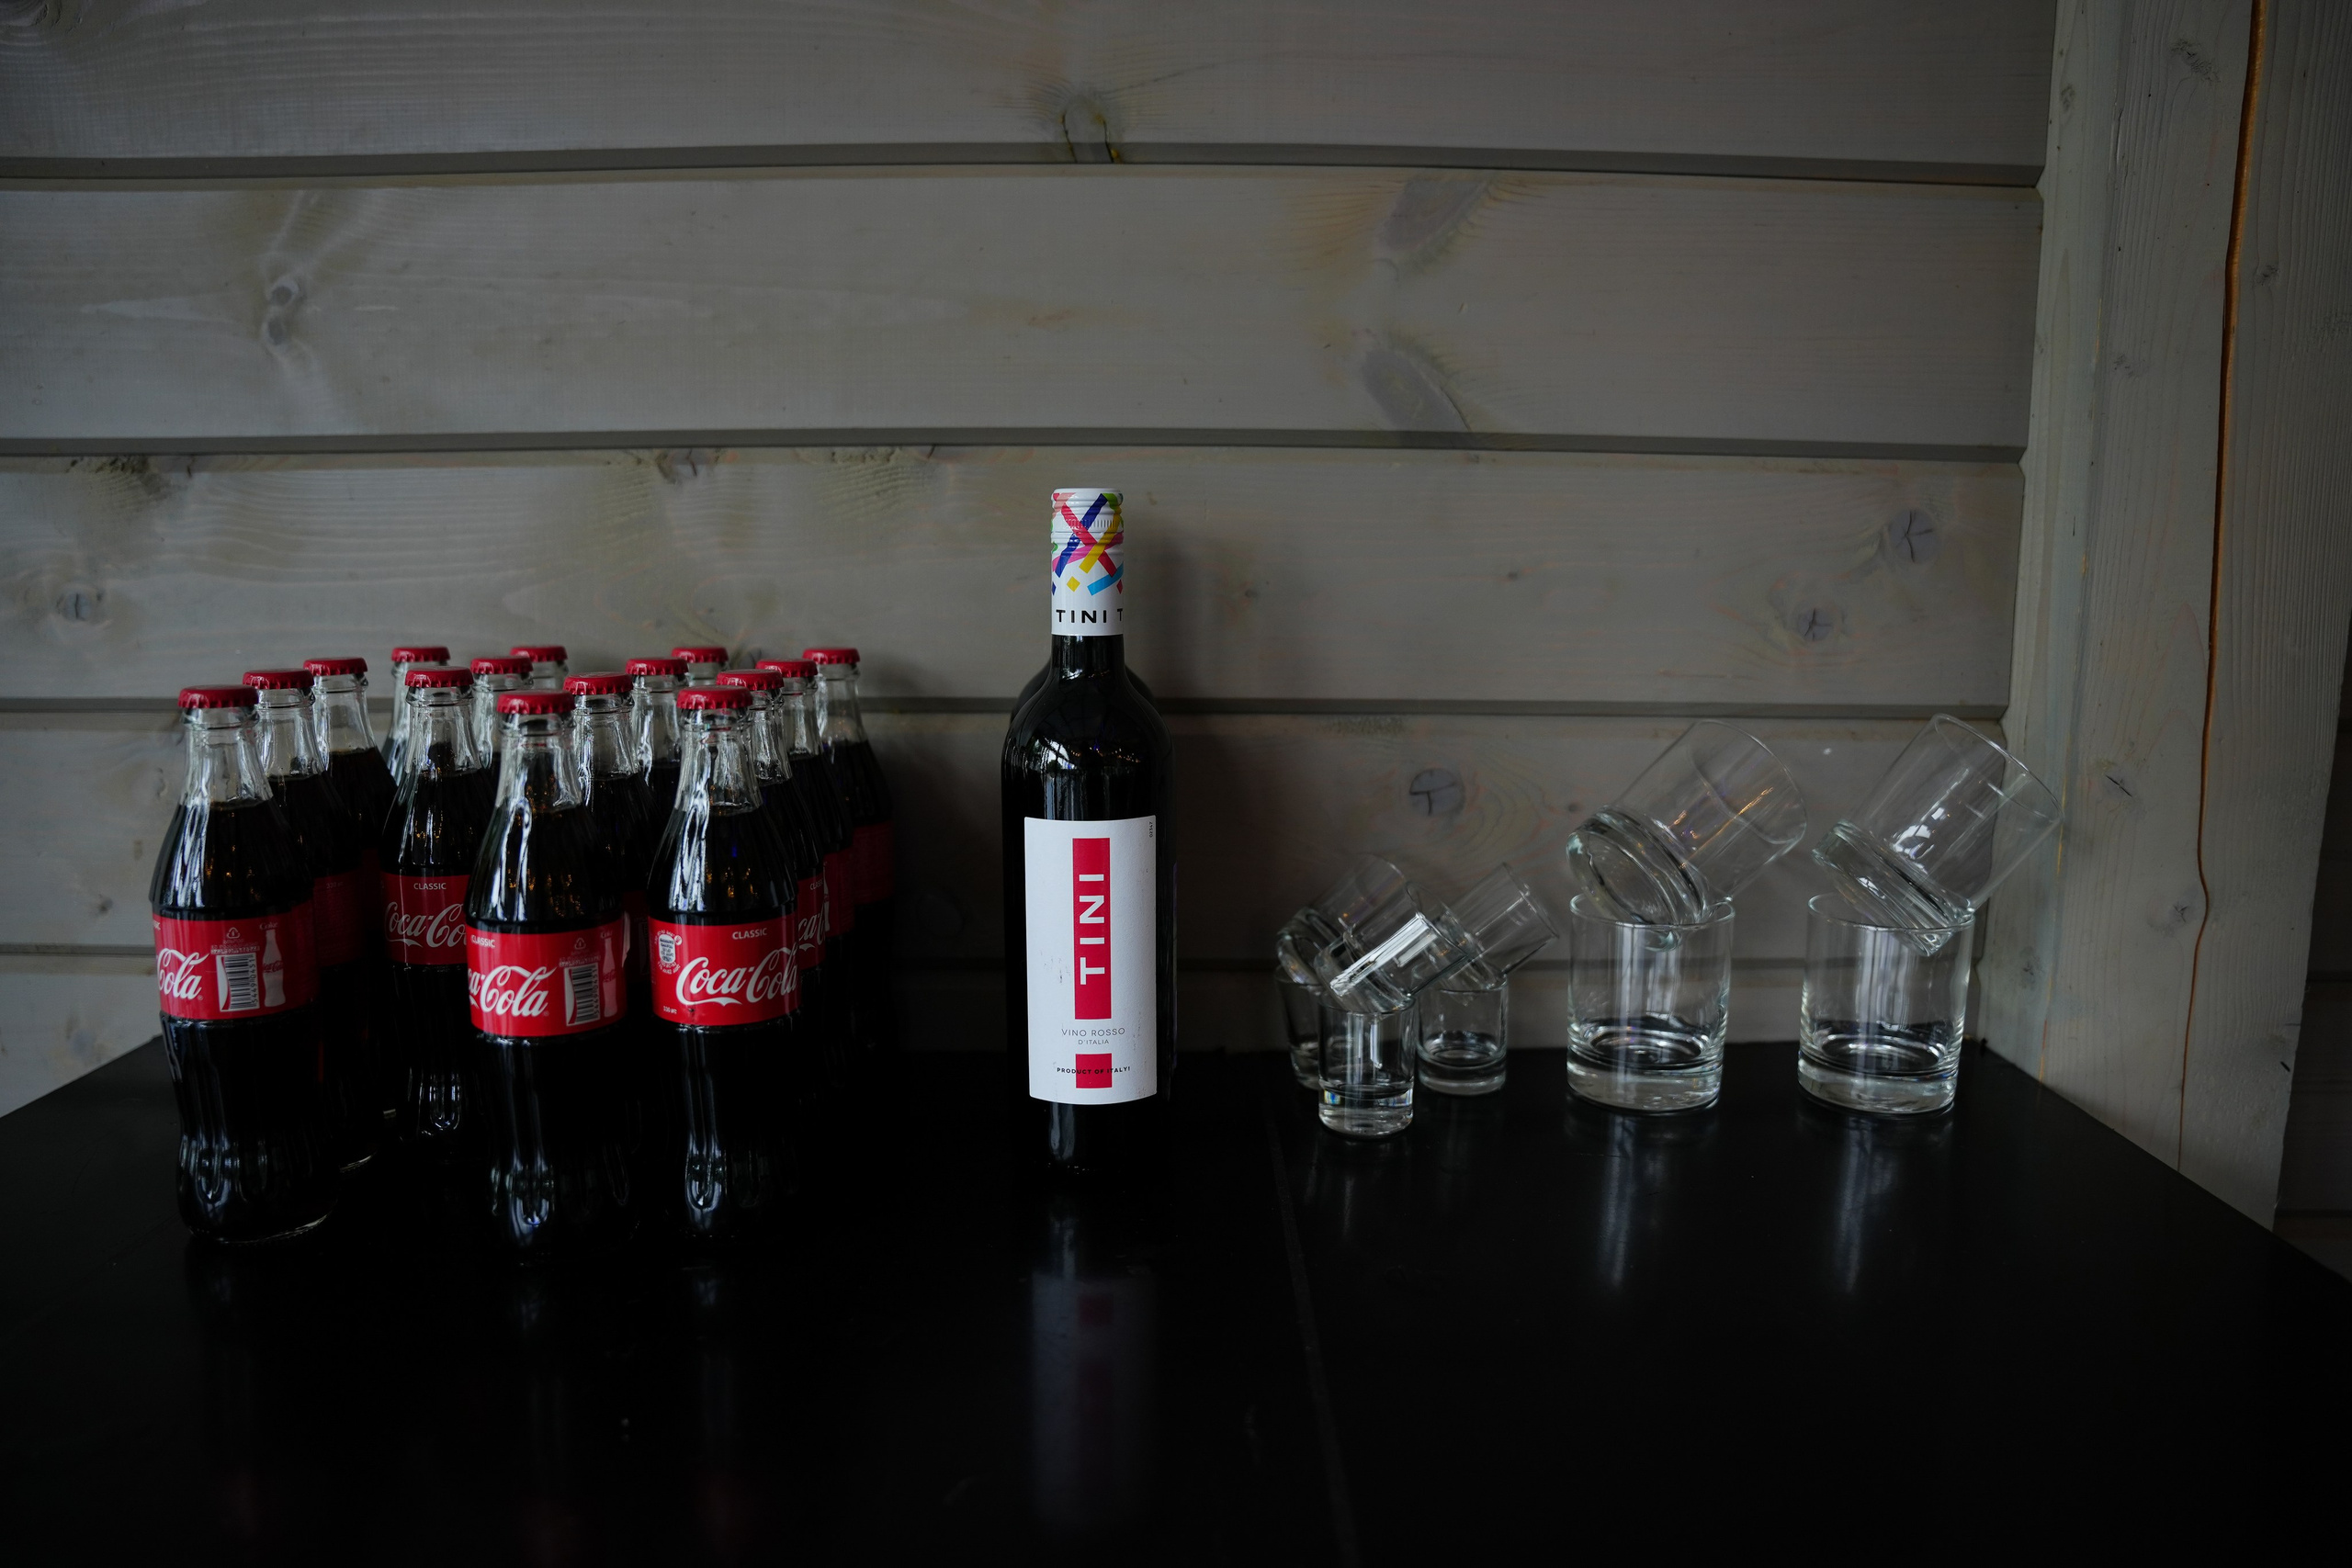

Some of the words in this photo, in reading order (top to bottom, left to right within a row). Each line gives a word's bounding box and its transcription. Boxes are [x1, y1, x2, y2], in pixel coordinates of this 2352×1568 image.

[1056, 610, 1107, 624] TINI
[385, 901, 467, 948] Coca-Co
[1079, 874, 1105, 986] TINI
[470, 934, 496, 948] CLASSIC
[731, 927, 768, 941] CLASSIC
[675, 942, 798, 1007] Coca-Cola
[1061, 1029, 1087, 1037] VINO
[1091, 1027, 1125, 1037] ROSSO
[1057, 1066, 1092, 1075] PRODUCT
